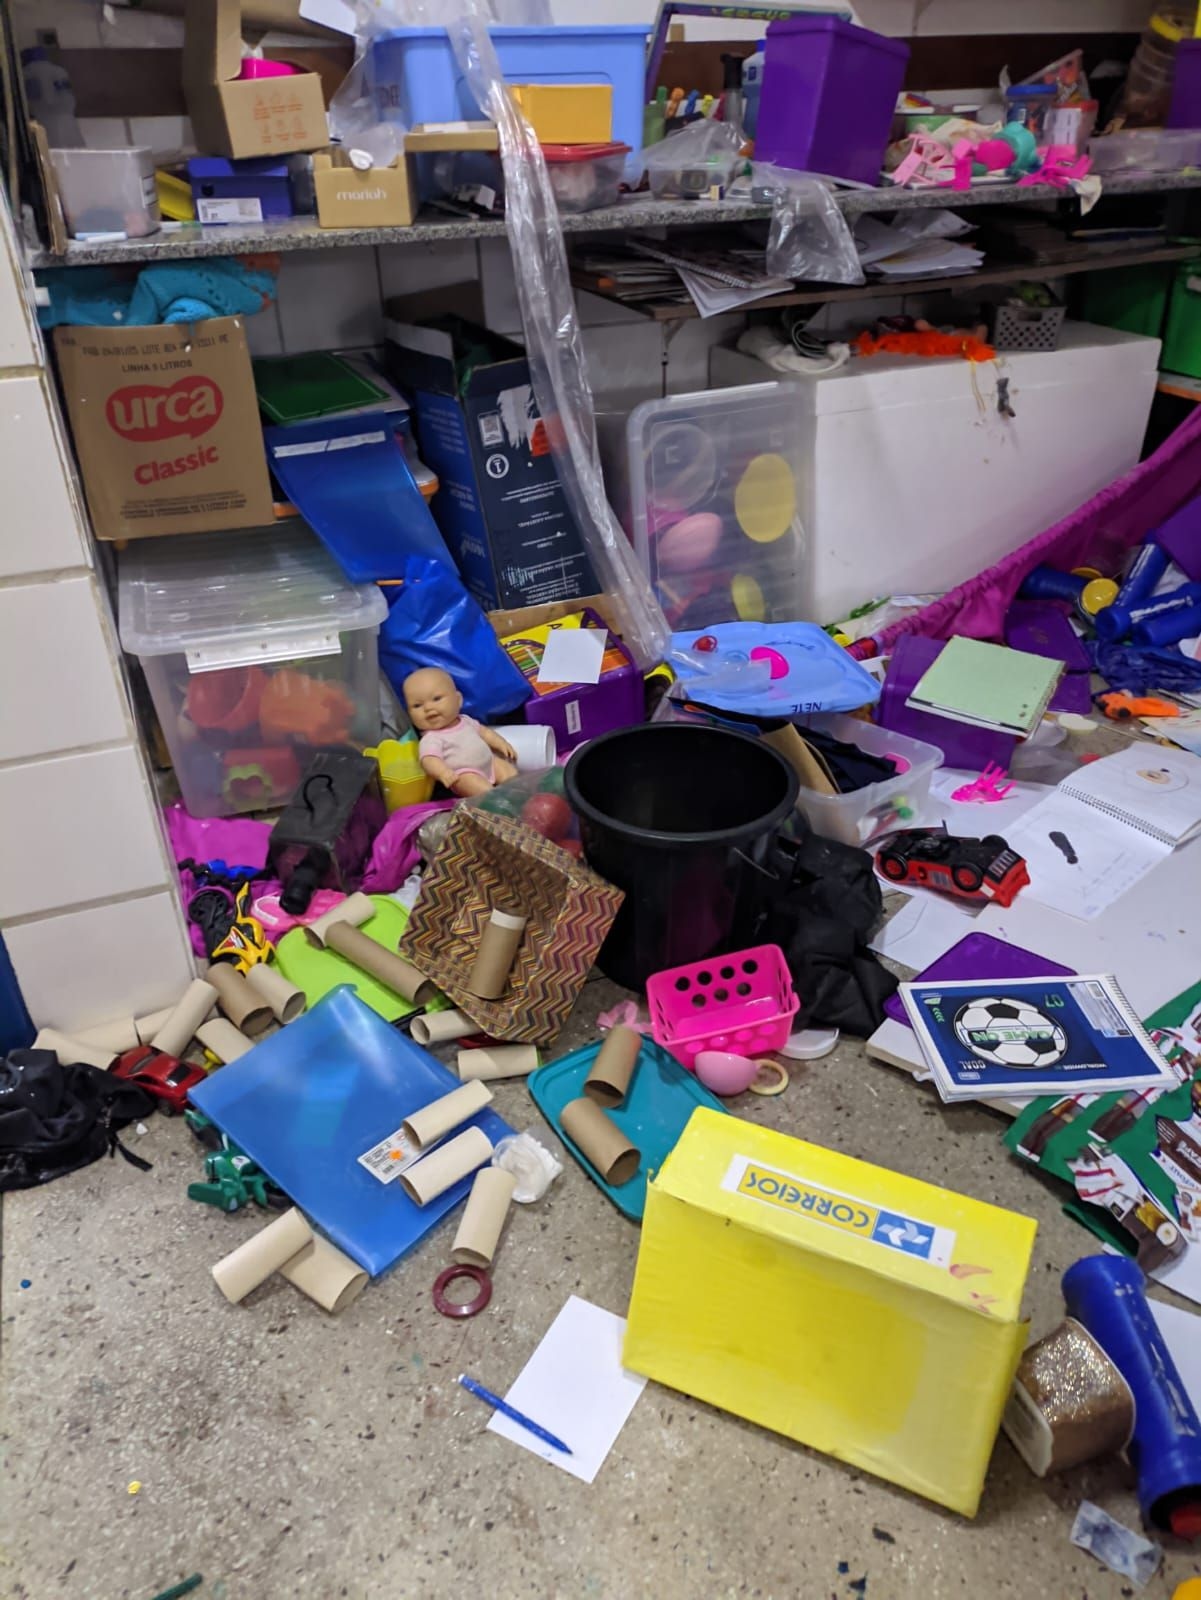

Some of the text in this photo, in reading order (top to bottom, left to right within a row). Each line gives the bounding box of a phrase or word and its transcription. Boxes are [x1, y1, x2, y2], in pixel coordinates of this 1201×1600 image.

[122, 362, 151, 373] LINHA
[160, 360, 193, 371] LITROS
[112, 386, 216, 431] urca
[134, 445, 219, 485] Classic
[971, 1031, 998, 1042] ON
[959, 1060, 986, 1070] GOAL
[747, 1172, 869, 1228] CORREIOS
